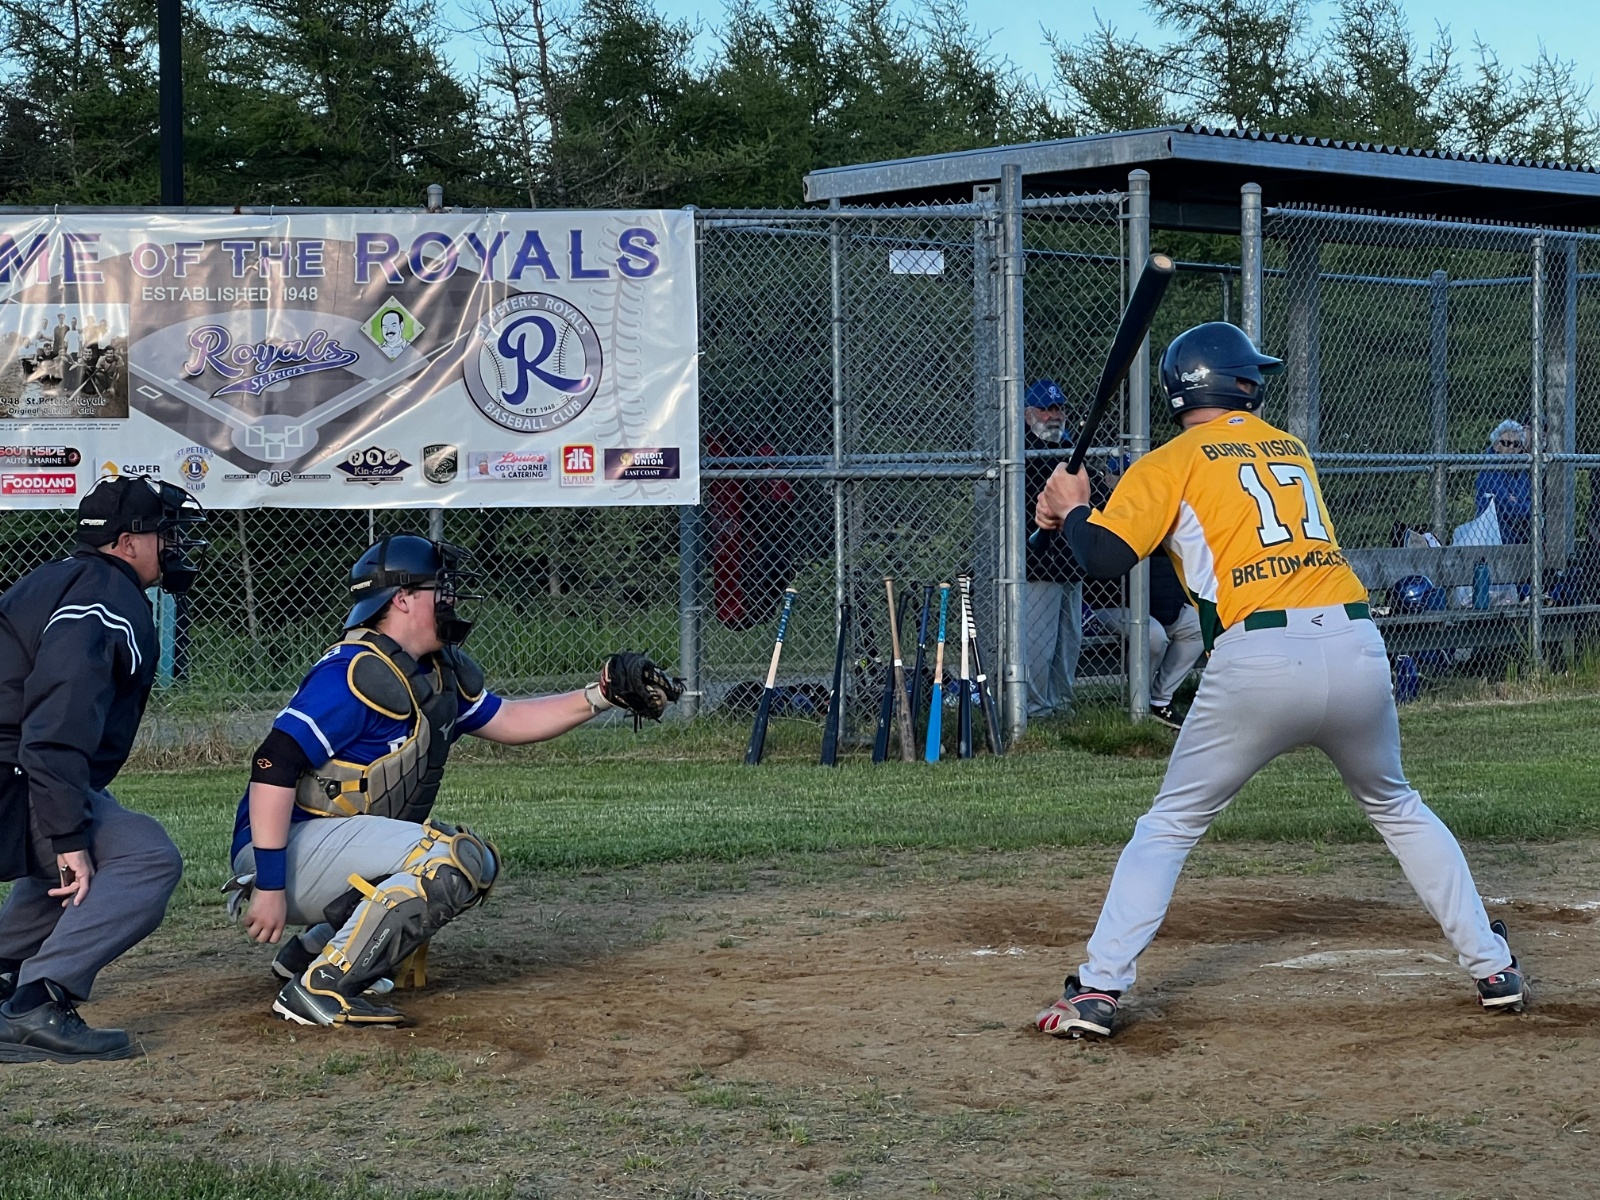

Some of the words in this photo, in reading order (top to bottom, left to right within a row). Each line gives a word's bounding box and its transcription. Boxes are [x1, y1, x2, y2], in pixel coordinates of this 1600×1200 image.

[130, 241, 204, 279] OF
[221, 241, 325, 279] THE
[353, 227, 660, 284] ROYALS
[142, 286, 271, 301] ESTABLISHED
[284, 286, 318, 301] 1948
[544, 297, 590, 335] ROYALS
[184, 325, 344, 379] Royals
[497, 315, 592, 406] R
[484, 401, 548, 430] BASEBALL
[551, 400, 582, 424] CLUB
[540, 403, 556, 413] 1948
[0, 446, 66, 456] SOUTHSIDE
[1200, 442, 1257, 461] BURNS
[1255, 439, 1308, 459] VISION
[122, 464, 161, 473] CAPER
[494, 464, 515, 472] COSY
[517, 463, 548, 471] CORNER
[634, 458, 664, 466] UNION
[2, 475, 74, 488] FOODLAND
[186, 482, 206, 491] CLUB
[1238, 462, 1332, 548] 17
[1231, 555, 1301, 588] BRETON
